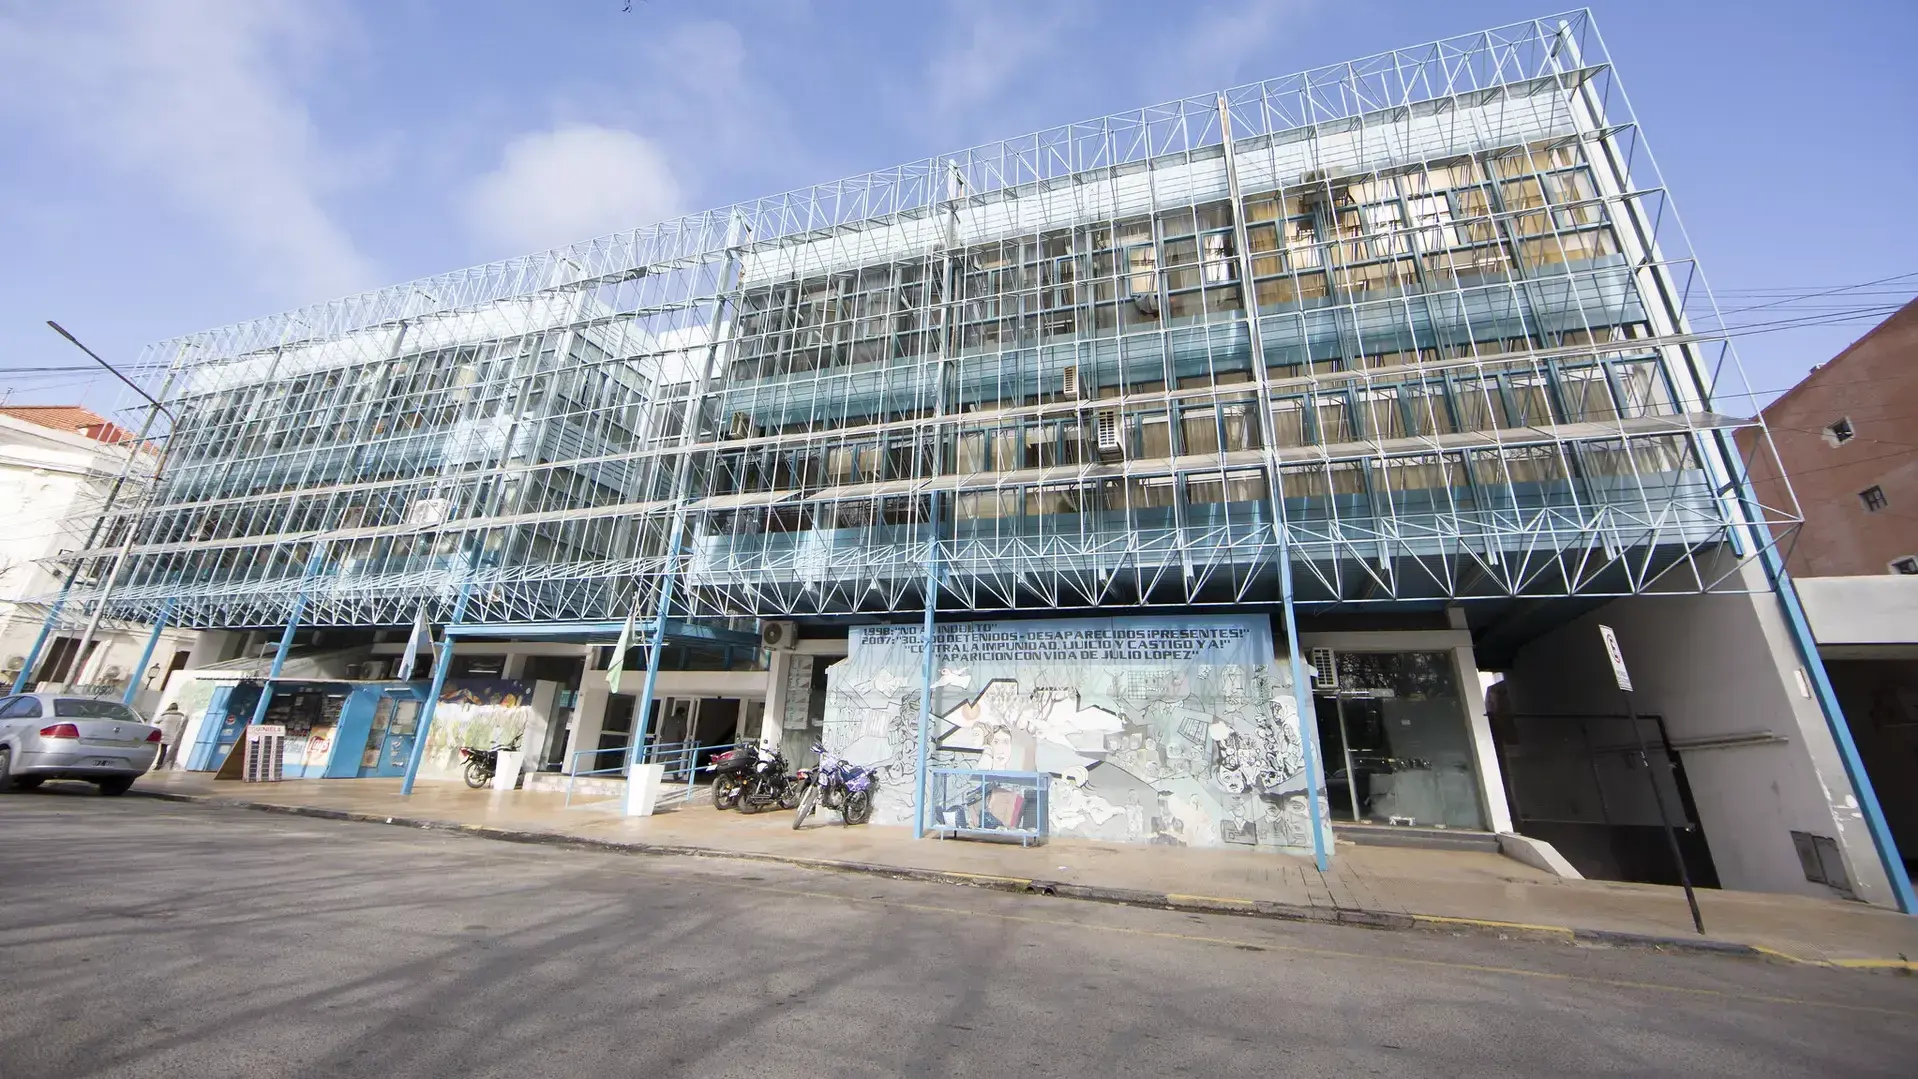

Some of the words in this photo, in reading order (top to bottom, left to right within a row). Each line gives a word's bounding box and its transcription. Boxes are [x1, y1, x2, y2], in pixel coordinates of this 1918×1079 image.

[905, 644, 959, 653] "COTRA
[963, 644, 979, 652] LA
[1116, 640, 1123, 649] Y
[1128, 640, 1193, 649] CASTIGO
[1015, 651, 1041, 660] CON
[1044, 651, 1077, 660] VIDA
[1081, 650, 1098, 660] DE
[1101, 650, 1141, 659] JULIO
